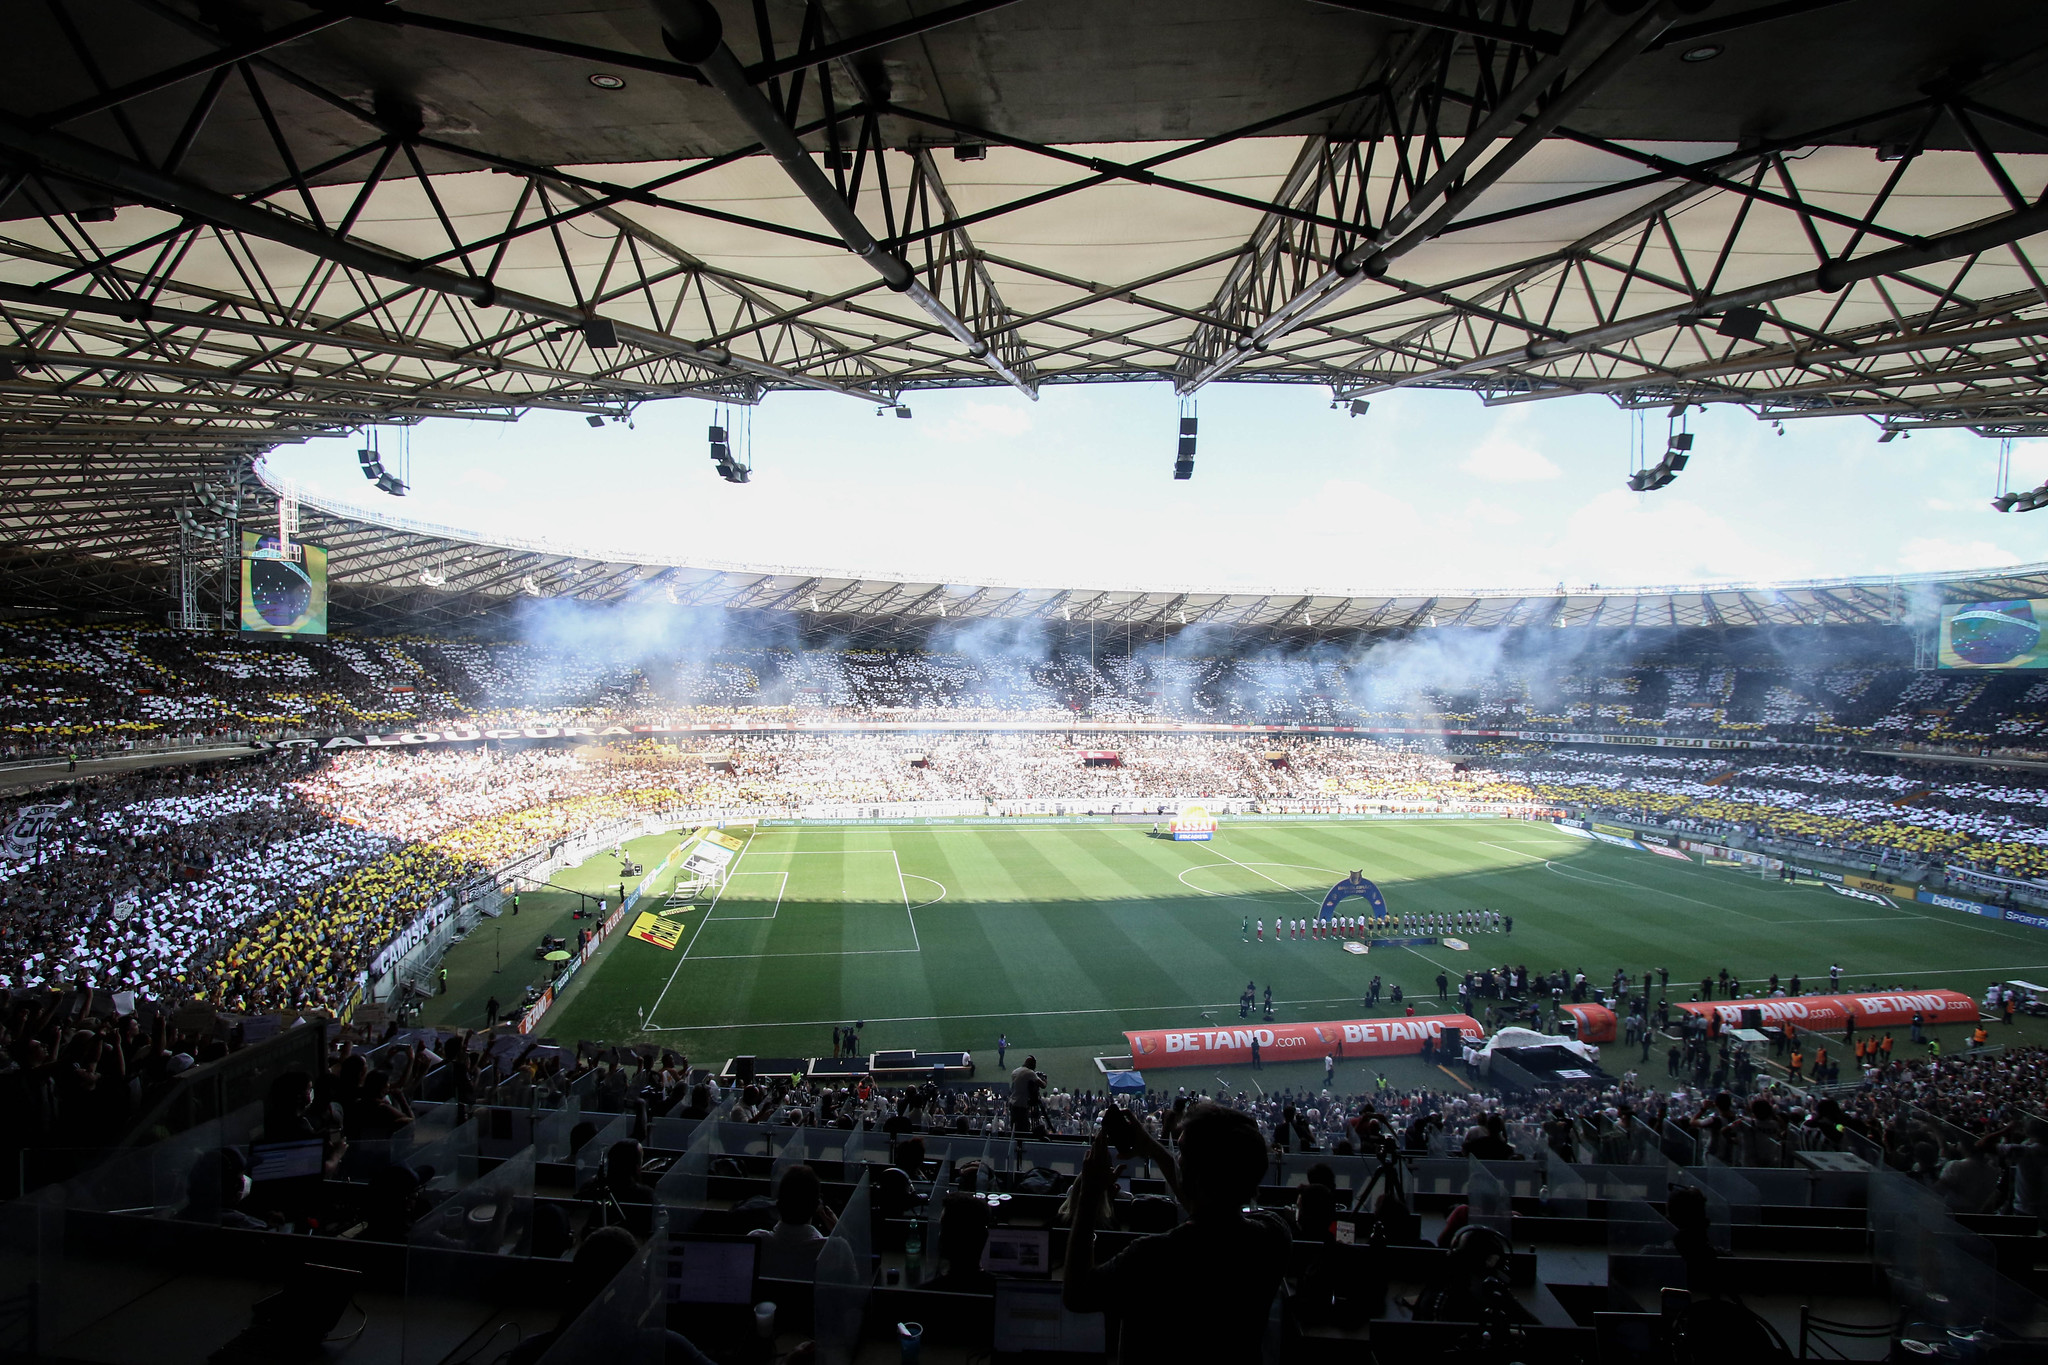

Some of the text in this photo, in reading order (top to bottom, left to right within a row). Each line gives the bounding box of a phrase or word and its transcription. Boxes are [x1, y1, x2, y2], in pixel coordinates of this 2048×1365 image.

[1603, 735, 1750, 749] UNIDOS PELO GALO
[1641, 833, 1669, 847] bodog
[1819, 871, 1843, 882] SICOOB
[1860, 880, 1895, 894] vonder
[1931, 894, 1982, 915] betcris
[2005, 910, 2038, 926] SPORT
[380, 903, 446, 975] CAMISA 13
[1715, 1001, 1835, 1023] BANO.com
